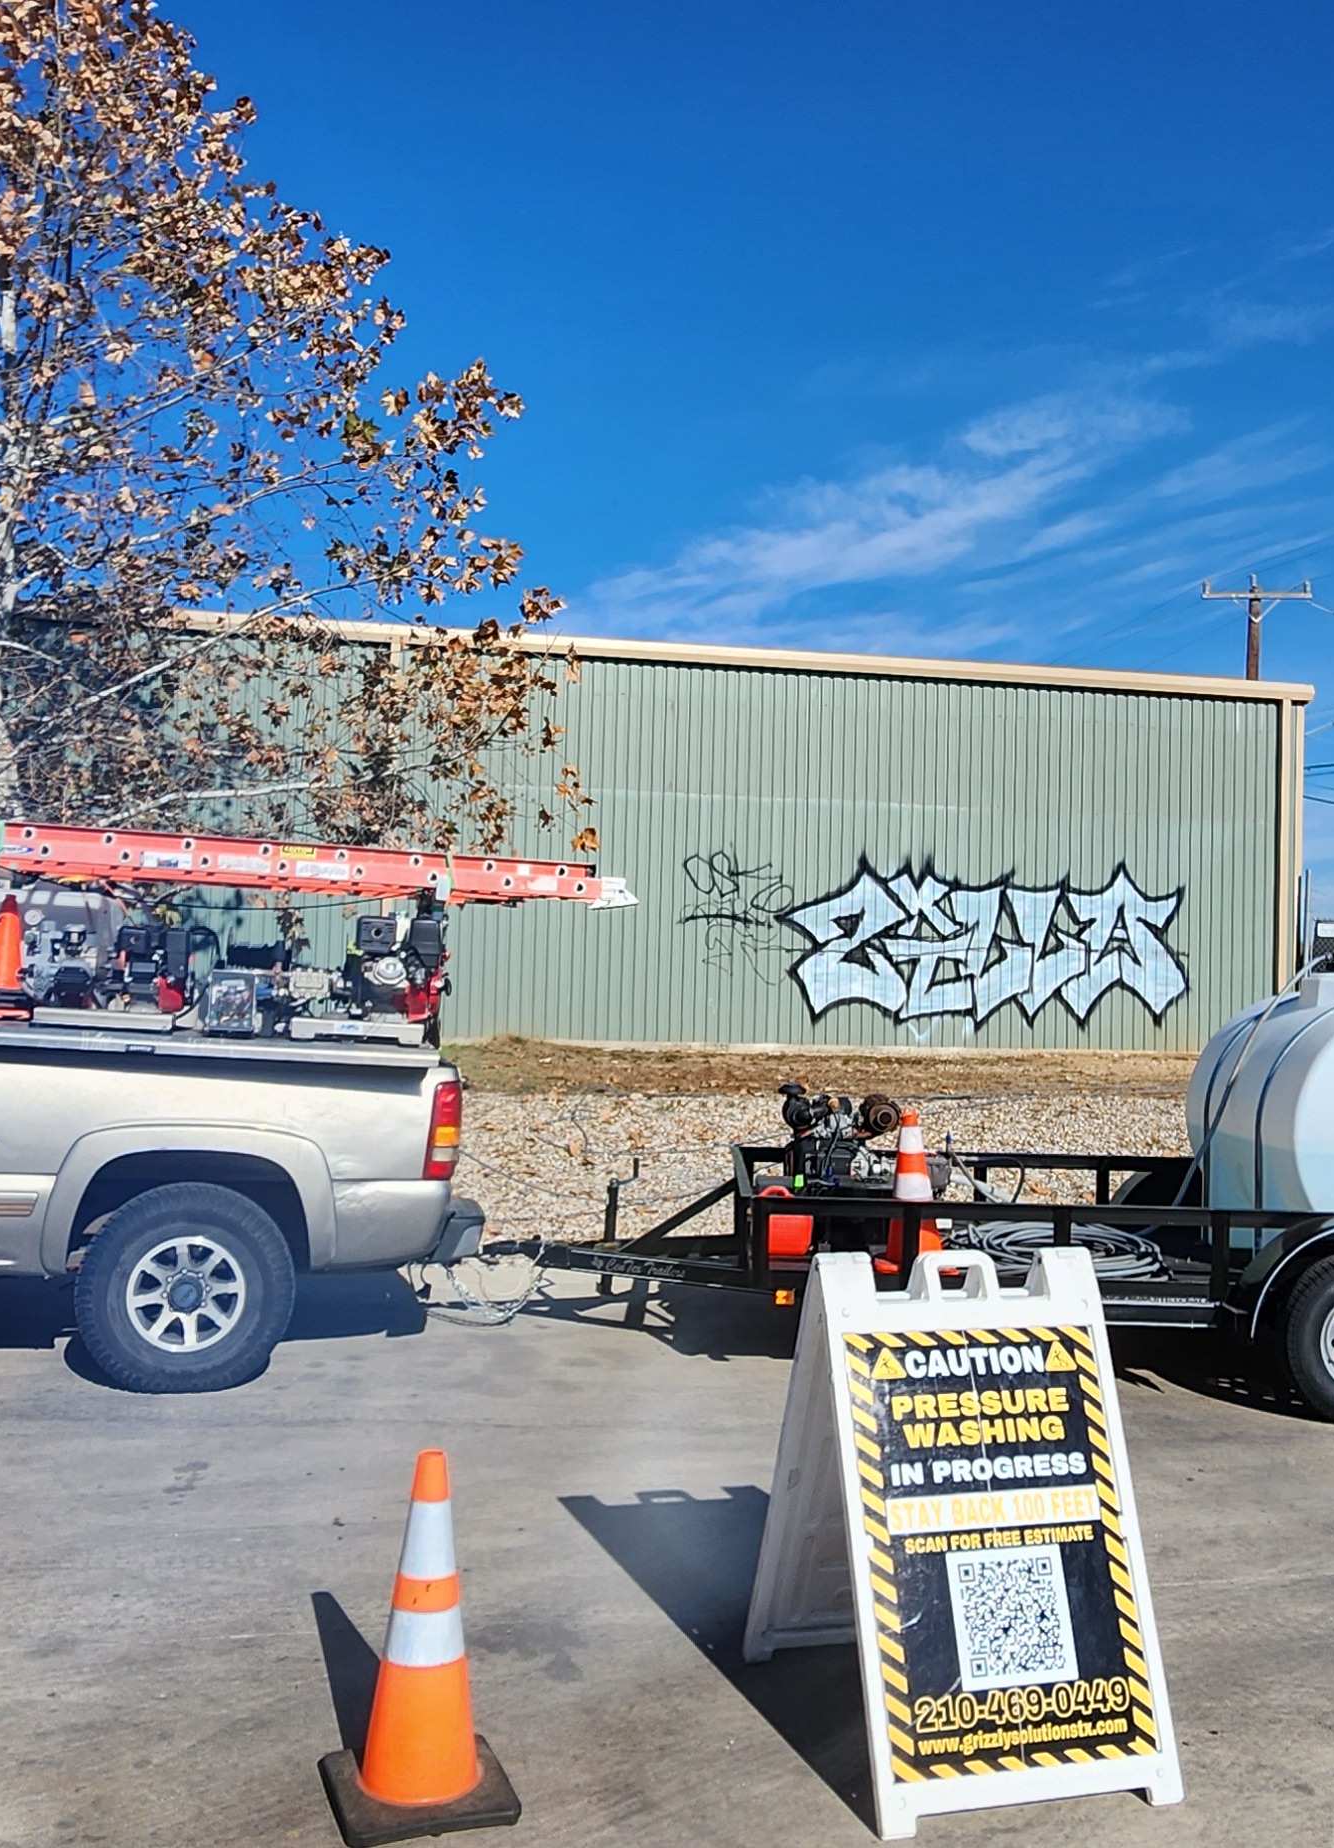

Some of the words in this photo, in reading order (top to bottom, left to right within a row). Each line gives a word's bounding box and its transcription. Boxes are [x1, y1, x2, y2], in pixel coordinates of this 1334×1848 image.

[644, 1261, 685, 1278] Trailers
[904, 1345, 1045, 1378] CAUTION
[890, 1387, 1070, 1421] PRESSURE
[902, 1415, 1066, 1449] WASHING
[890, 1462, 925, 1487] IN
[931, 1452, 1087, 1484] PROGRESS
[889, 1500, 942, 1531] STAY
[951, 1495, 1007, 1526] BACK
[1013, 1493, 1046, 1521] 100
[1051, 1490, 1096, 1518] FEET
[904, 1536, 948, 1554] SCAN
[950, 1533, 982, 1550] FOR
[984, 1530, 1022, 1547] FREE
[1024, 1525, 1094, 1546] ESTIMATE
[915, 1676, 1131, 1733] 210-469-0449
[918, 1718, 1128, 1756] www.grizzlysolutionstx.com
